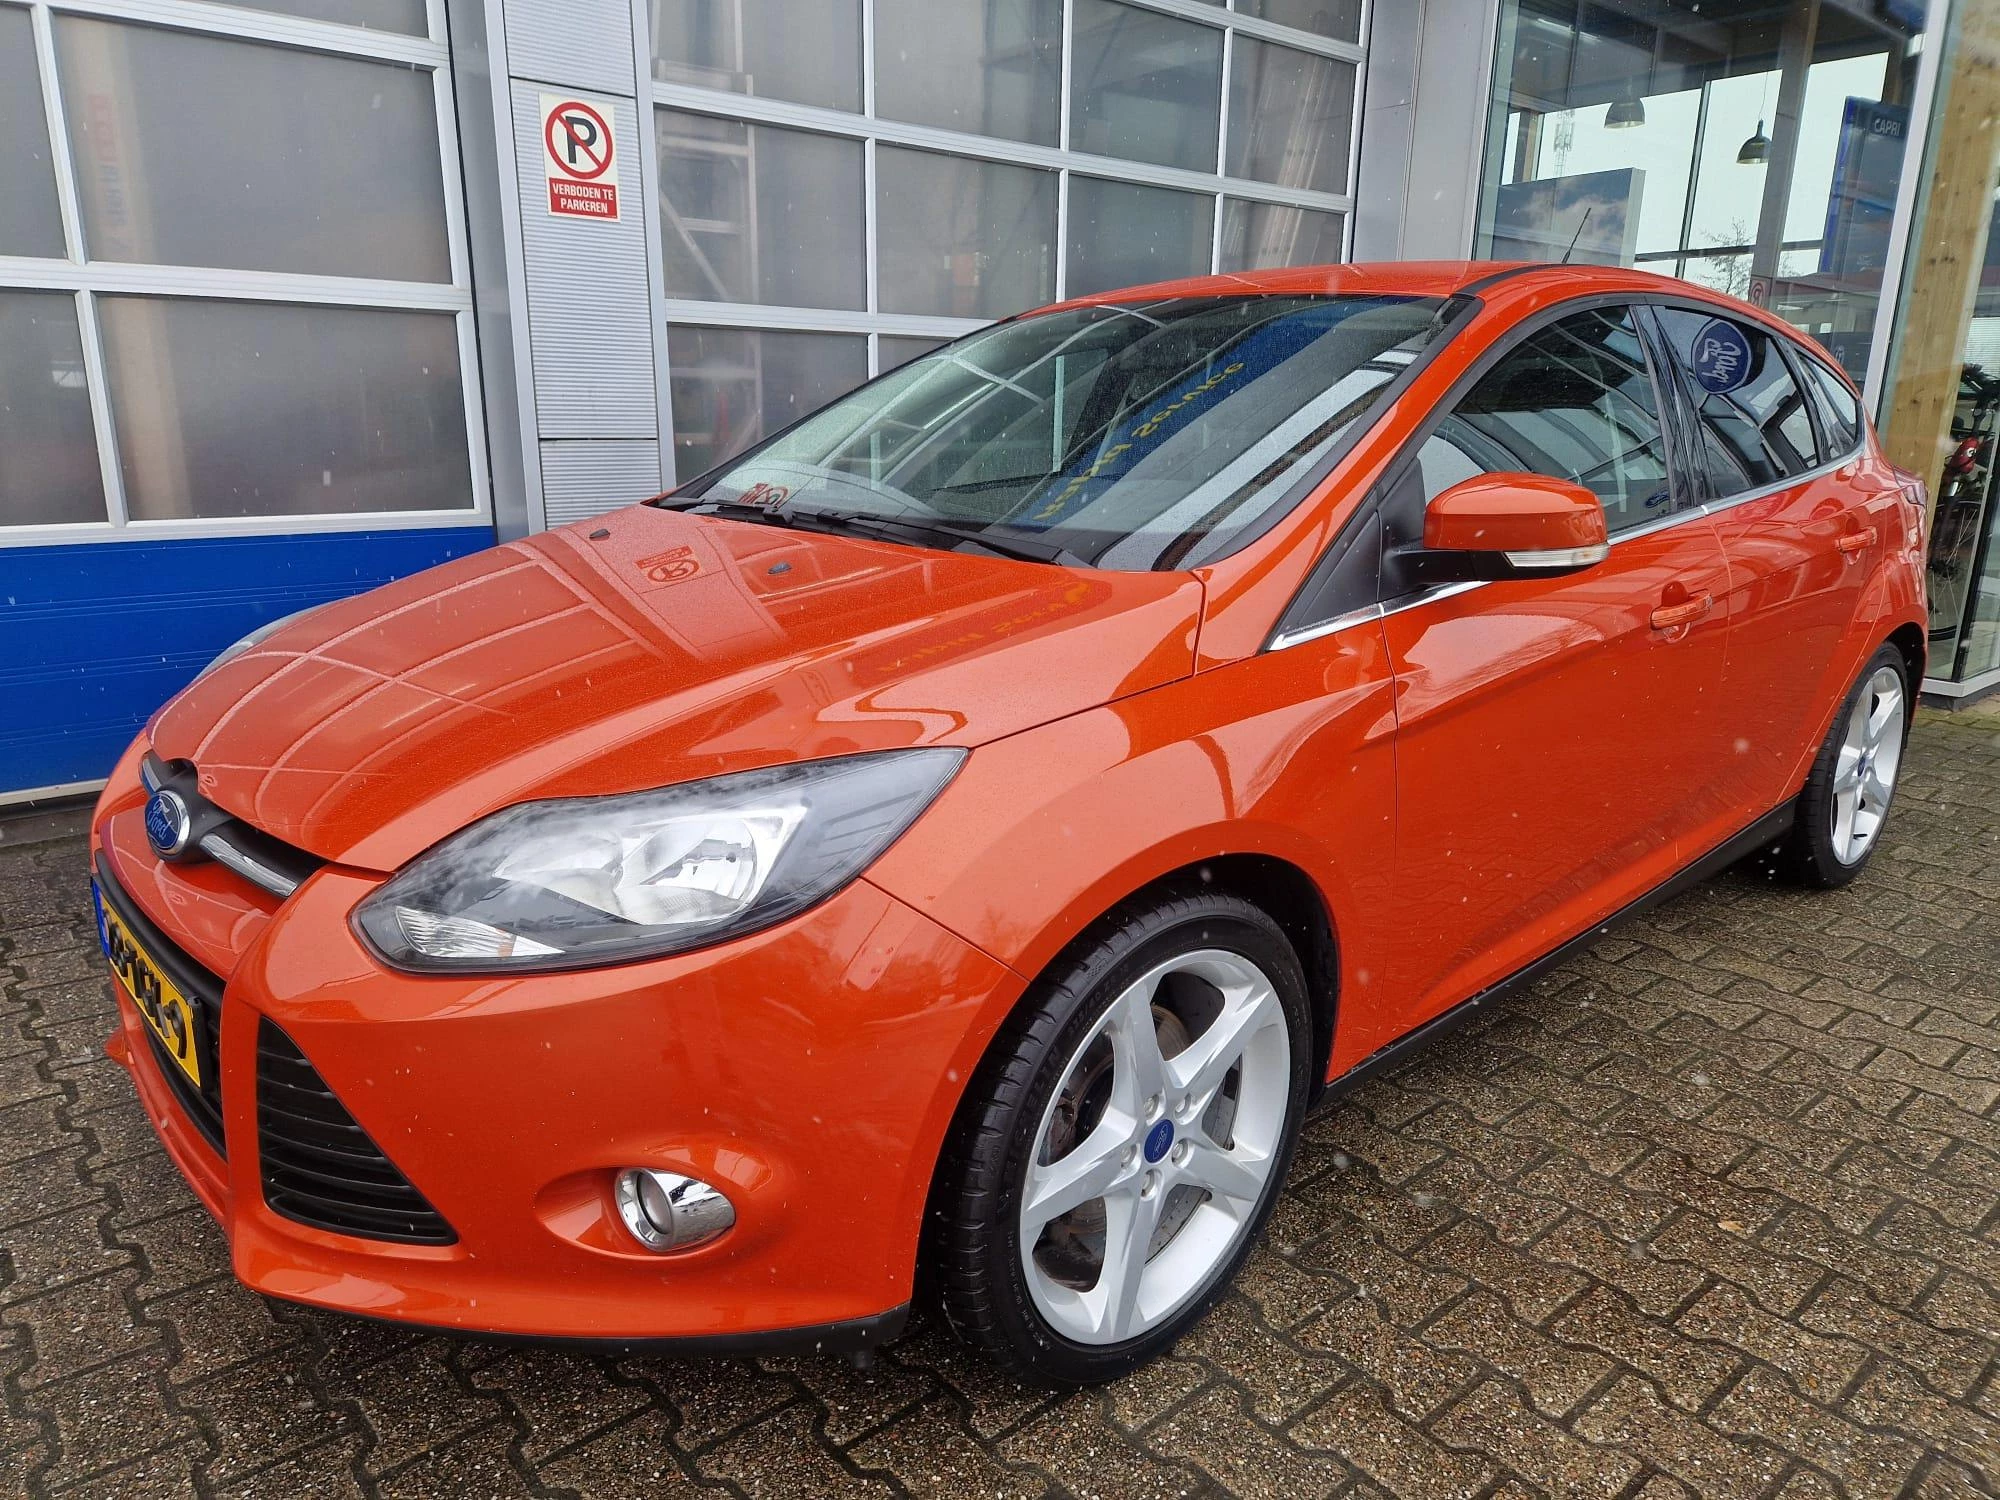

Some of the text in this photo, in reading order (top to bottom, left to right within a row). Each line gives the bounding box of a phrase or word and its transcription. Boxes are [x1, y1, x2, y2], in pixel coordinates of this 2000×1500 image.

[1874, 119, 1900, 136] CAPRI
[552, 182, 614, 201] VERBODEN TE
[560, 198, 608, 213] PARKEREN
[148, 798, 174, 840] Ford
